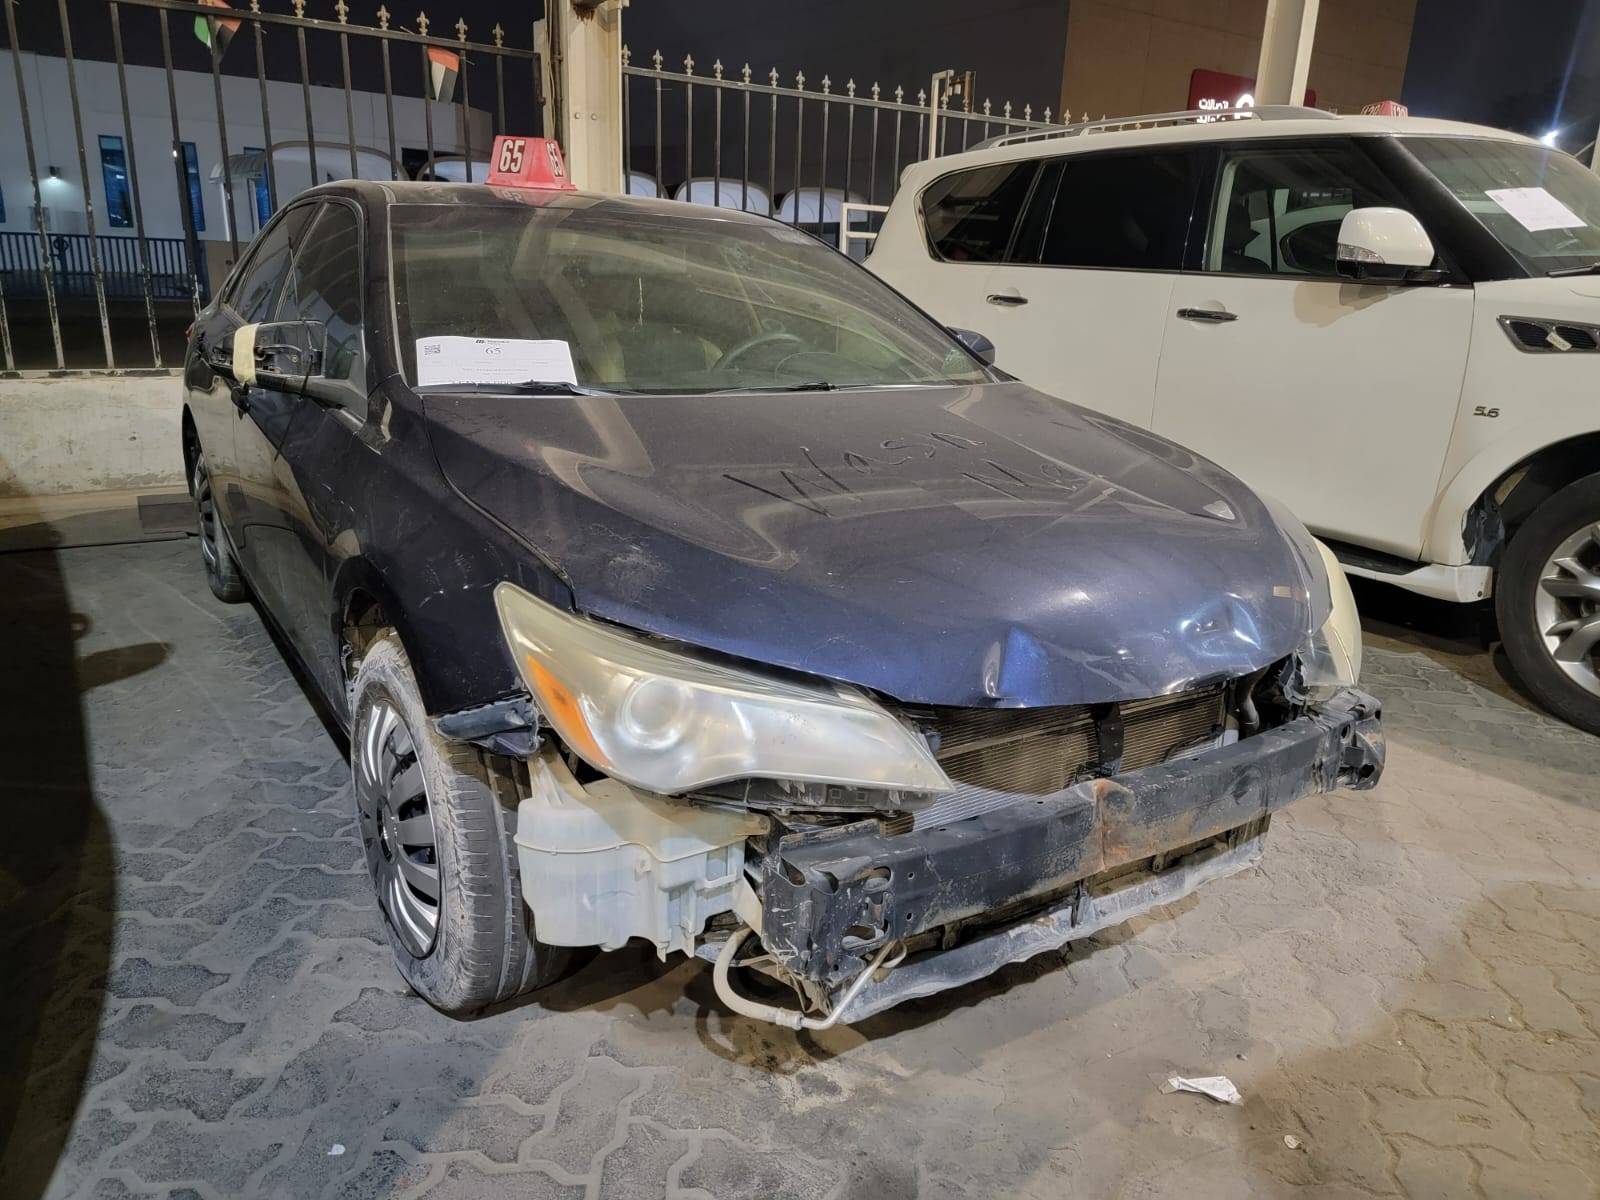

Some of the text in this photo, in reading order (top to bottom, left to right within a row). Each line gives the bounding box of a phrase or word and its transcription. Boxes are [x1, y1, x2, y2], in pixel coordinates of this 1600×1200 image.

[499, 139, 525, 173] 65
[546, 142, 563, 177] 65
[485, 346, 503, 355] 65
[1473, 406, 1500, 418] 5.6
